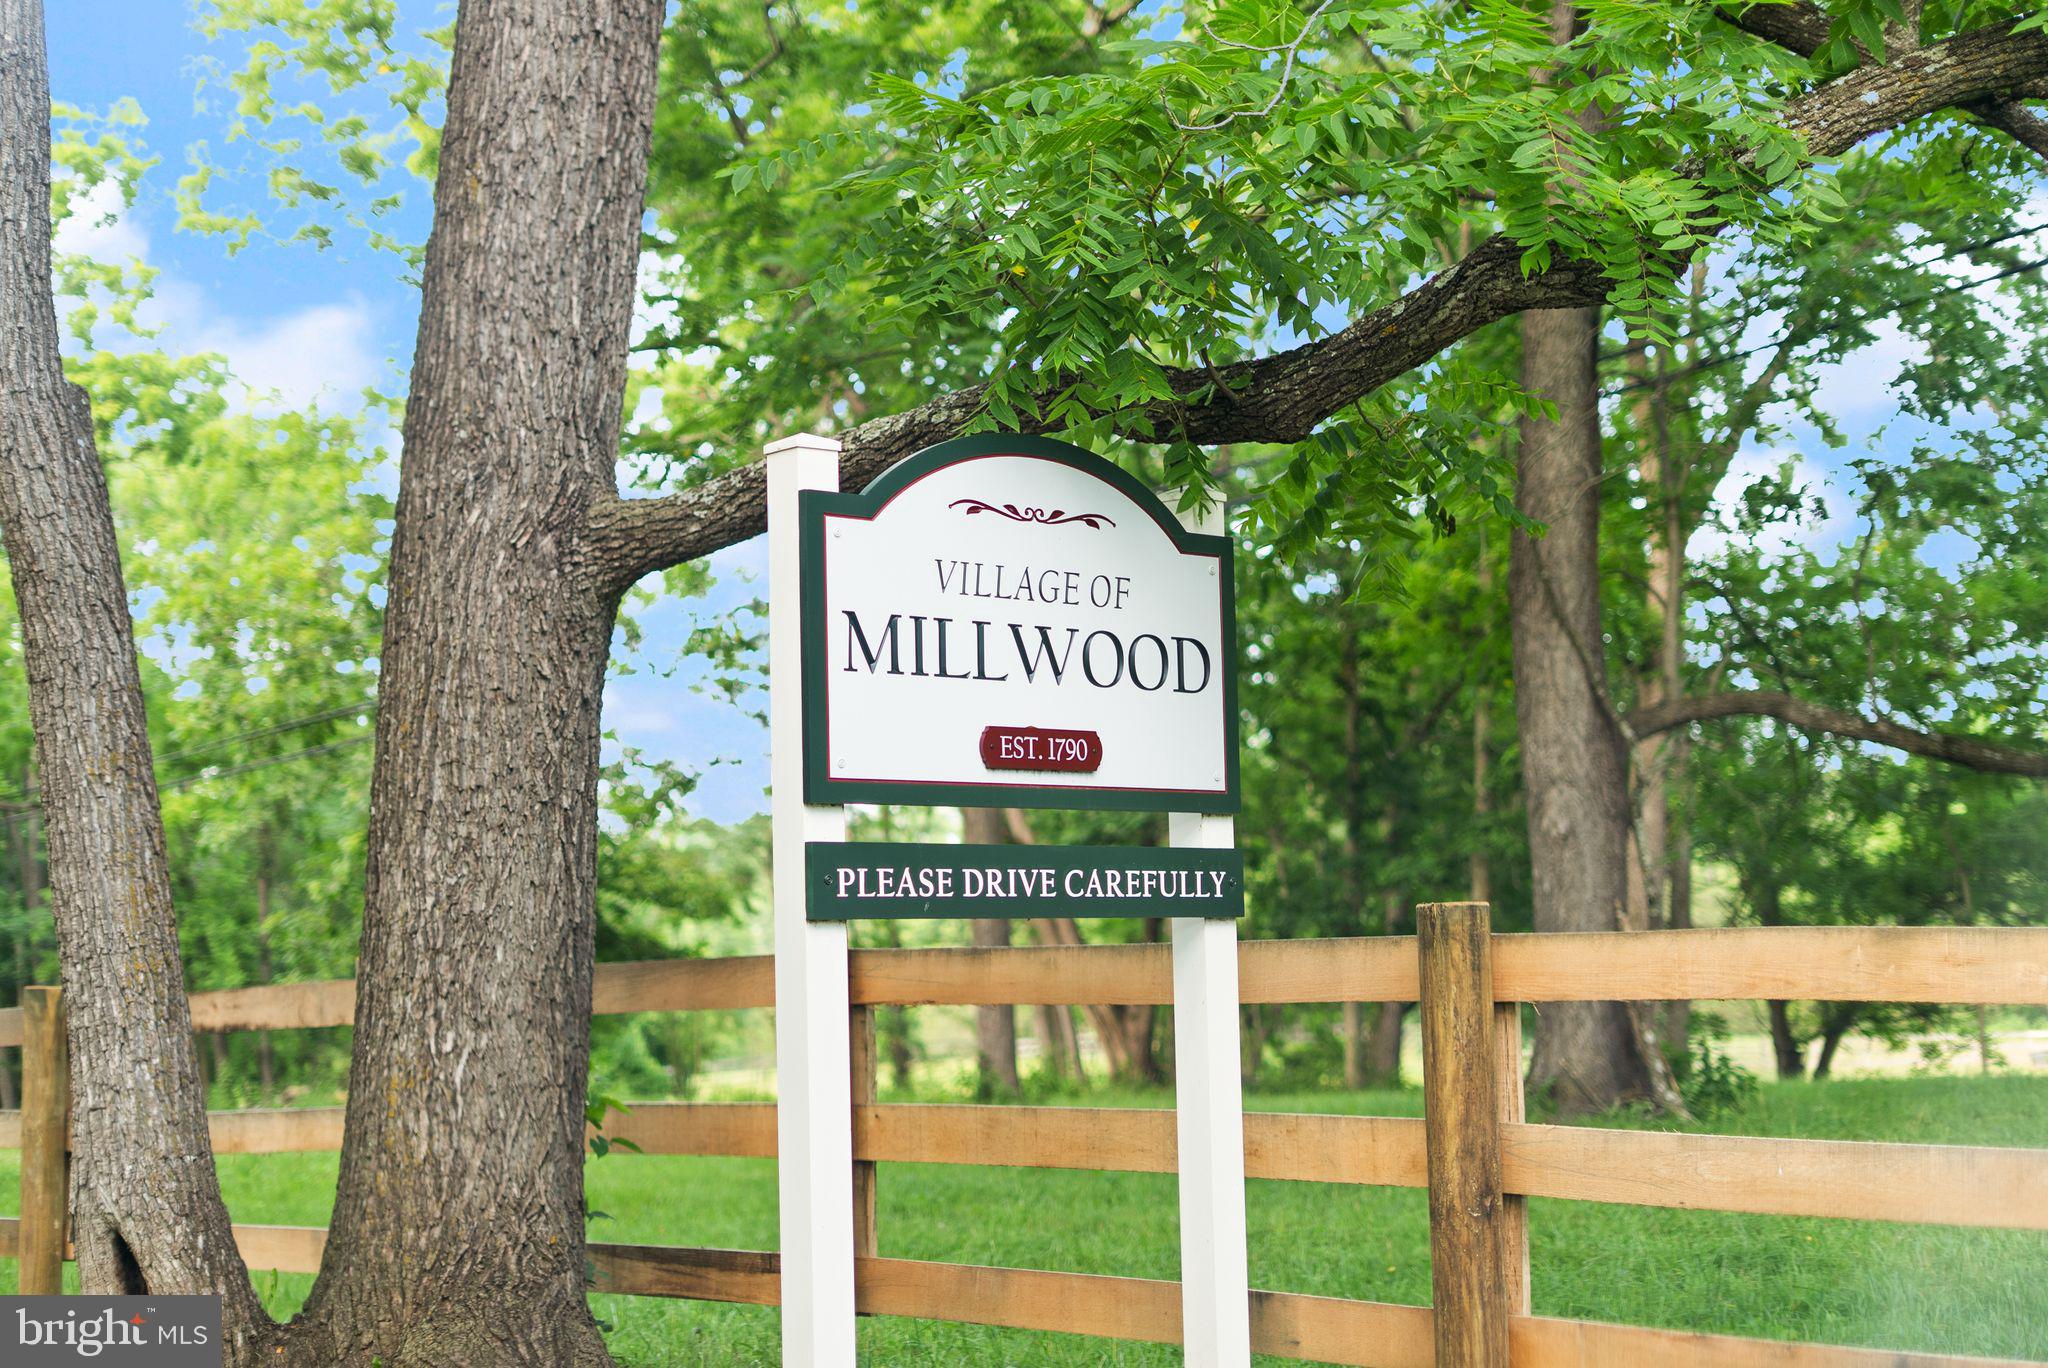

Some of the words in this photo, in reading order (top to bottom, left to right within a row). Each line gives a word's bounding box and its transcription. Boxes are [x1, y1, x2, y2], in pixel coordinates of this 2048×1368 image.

[934, 558, 1080, 606] VILLAGE
[1090, 574, 1131, 609] OF
[841, 610, 1211, 694] MILLWOOD
[999, 735, 1043, 760] EST.
[1047, 737, 1088, 762] 1790
[836, 867, 954, 899] PLEASE
[962, 868, 1057, 899] DRIVE
[1064, 869, 1227, 899] CAREFULLY
